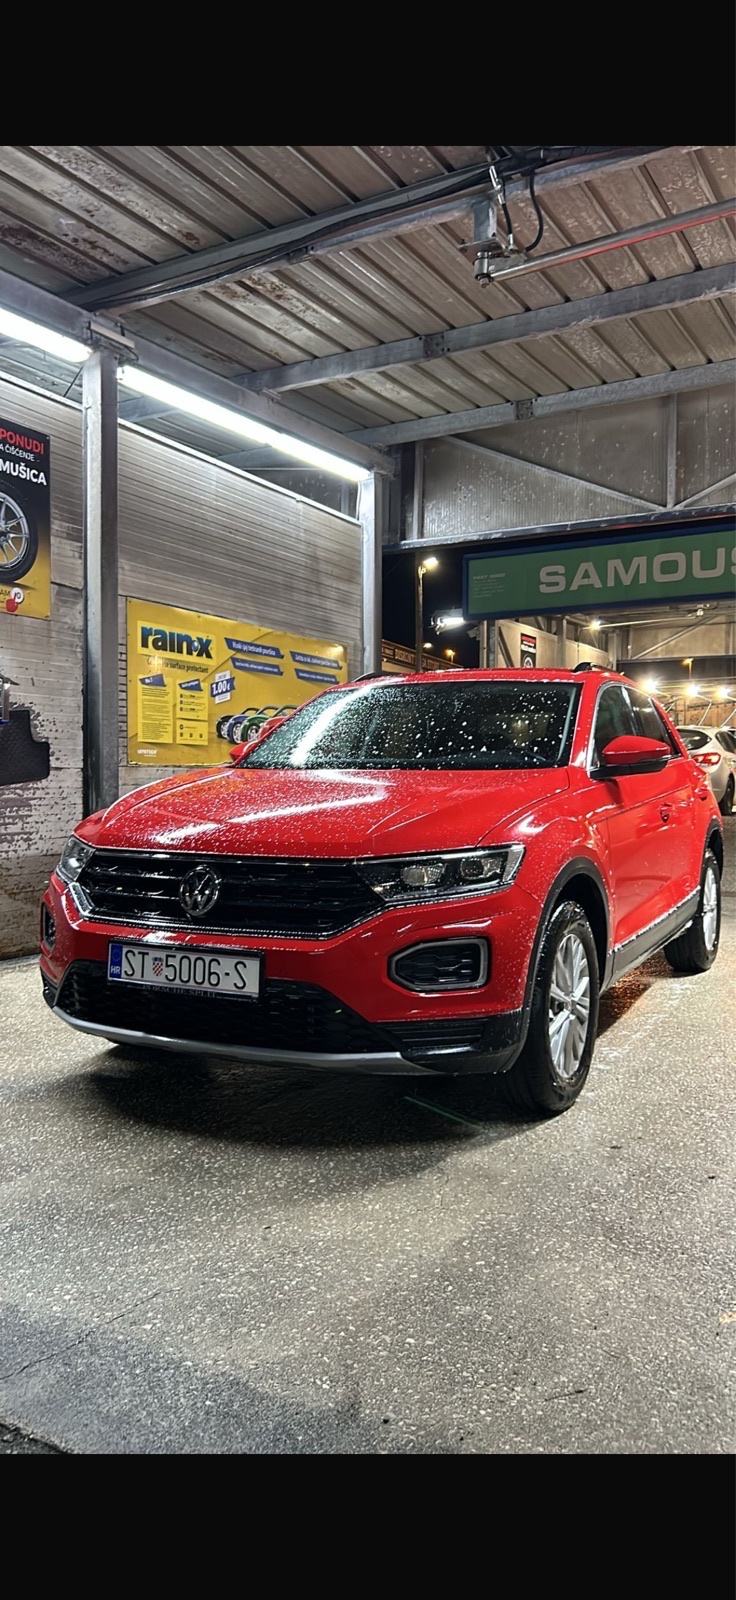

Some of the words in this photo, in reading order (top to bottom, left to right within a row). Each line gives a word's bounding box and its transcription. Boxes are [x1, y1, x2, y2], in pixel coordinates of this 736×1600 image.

[0, 428, 44, 455] PONUDI
[0, 458, 47, 486] MUŠICA
[539, 547, 736, 593] SAMOU
[110, 965, 121, 975] HR
[124, 949, 149, 978] ST
[165, 954, 247, 990] 5006-S
